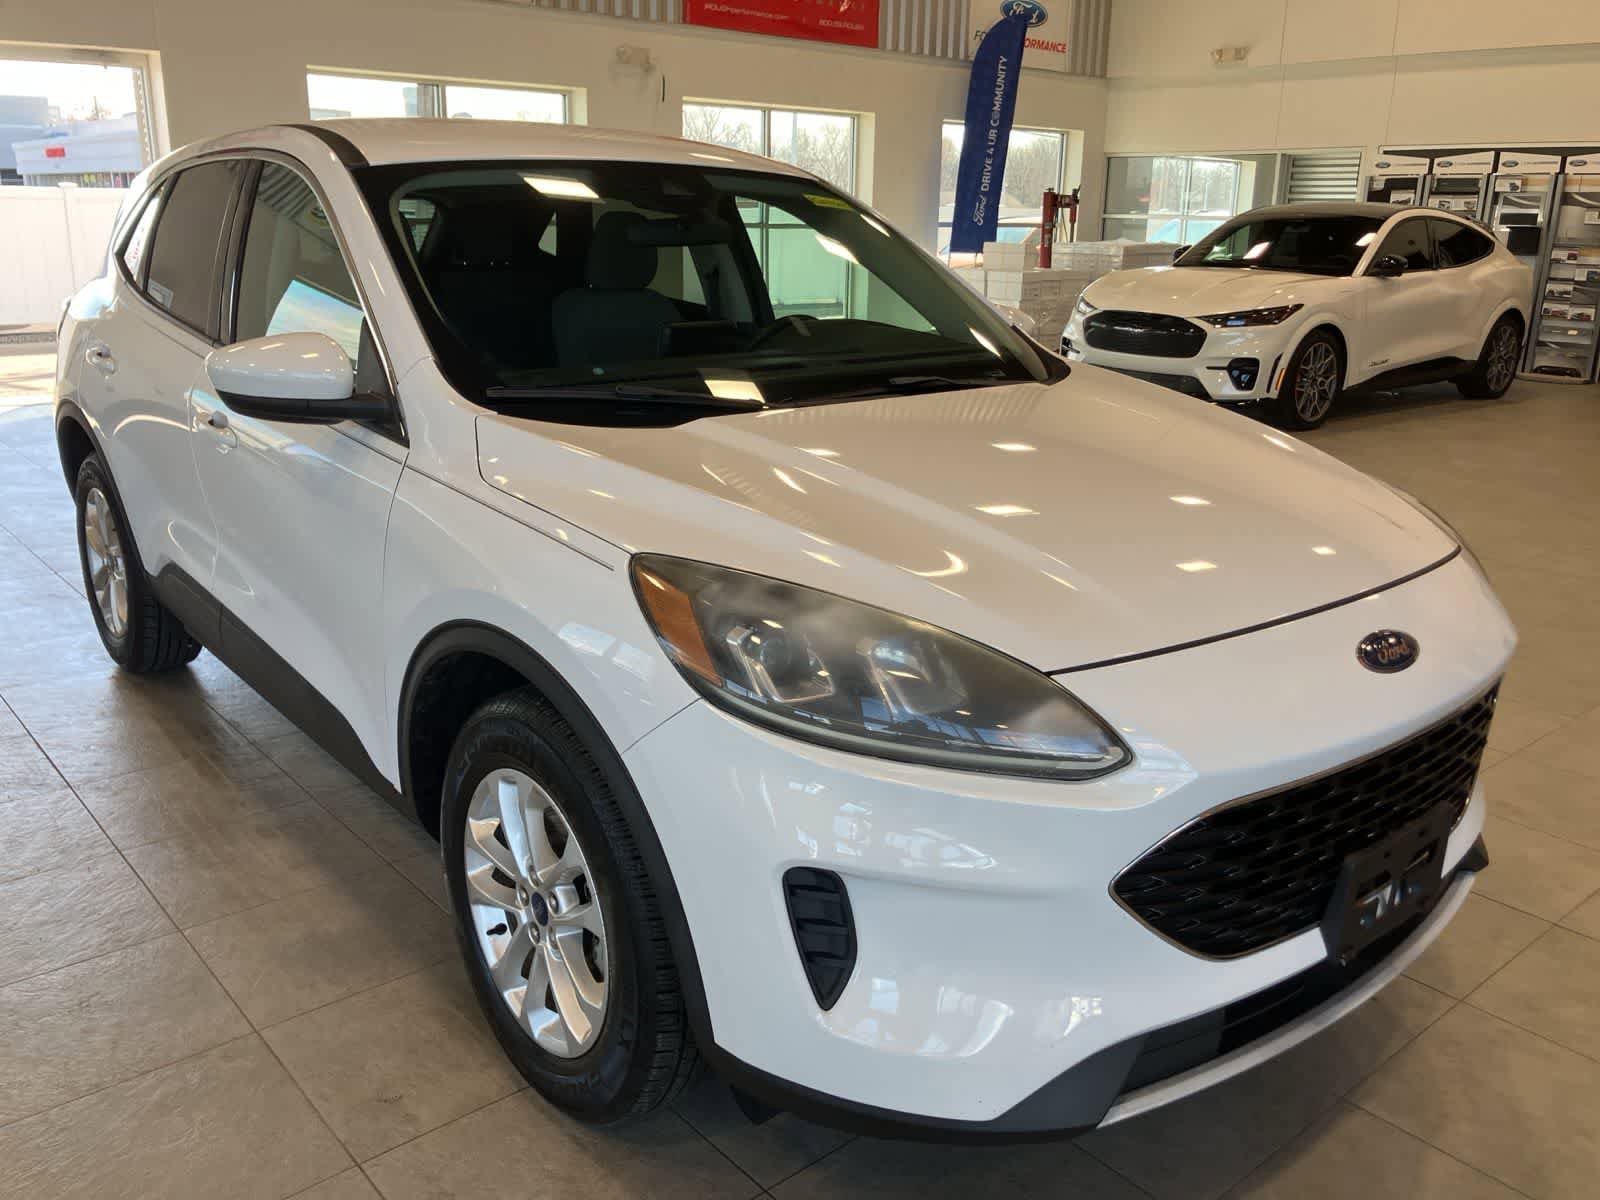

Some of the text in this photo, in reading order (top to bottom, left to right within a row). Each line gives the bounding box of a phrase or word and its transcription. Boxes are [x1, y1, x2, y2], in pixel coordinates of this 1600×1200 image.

[1023, 37, 1067, 54] ORMANCE
[989, 55, 1008, 127] COMMUNITY
[988, 129, 998, 146] UR
[980, 156, 994, 192] DRIVE
[972, 194, 988, 227] Ford
